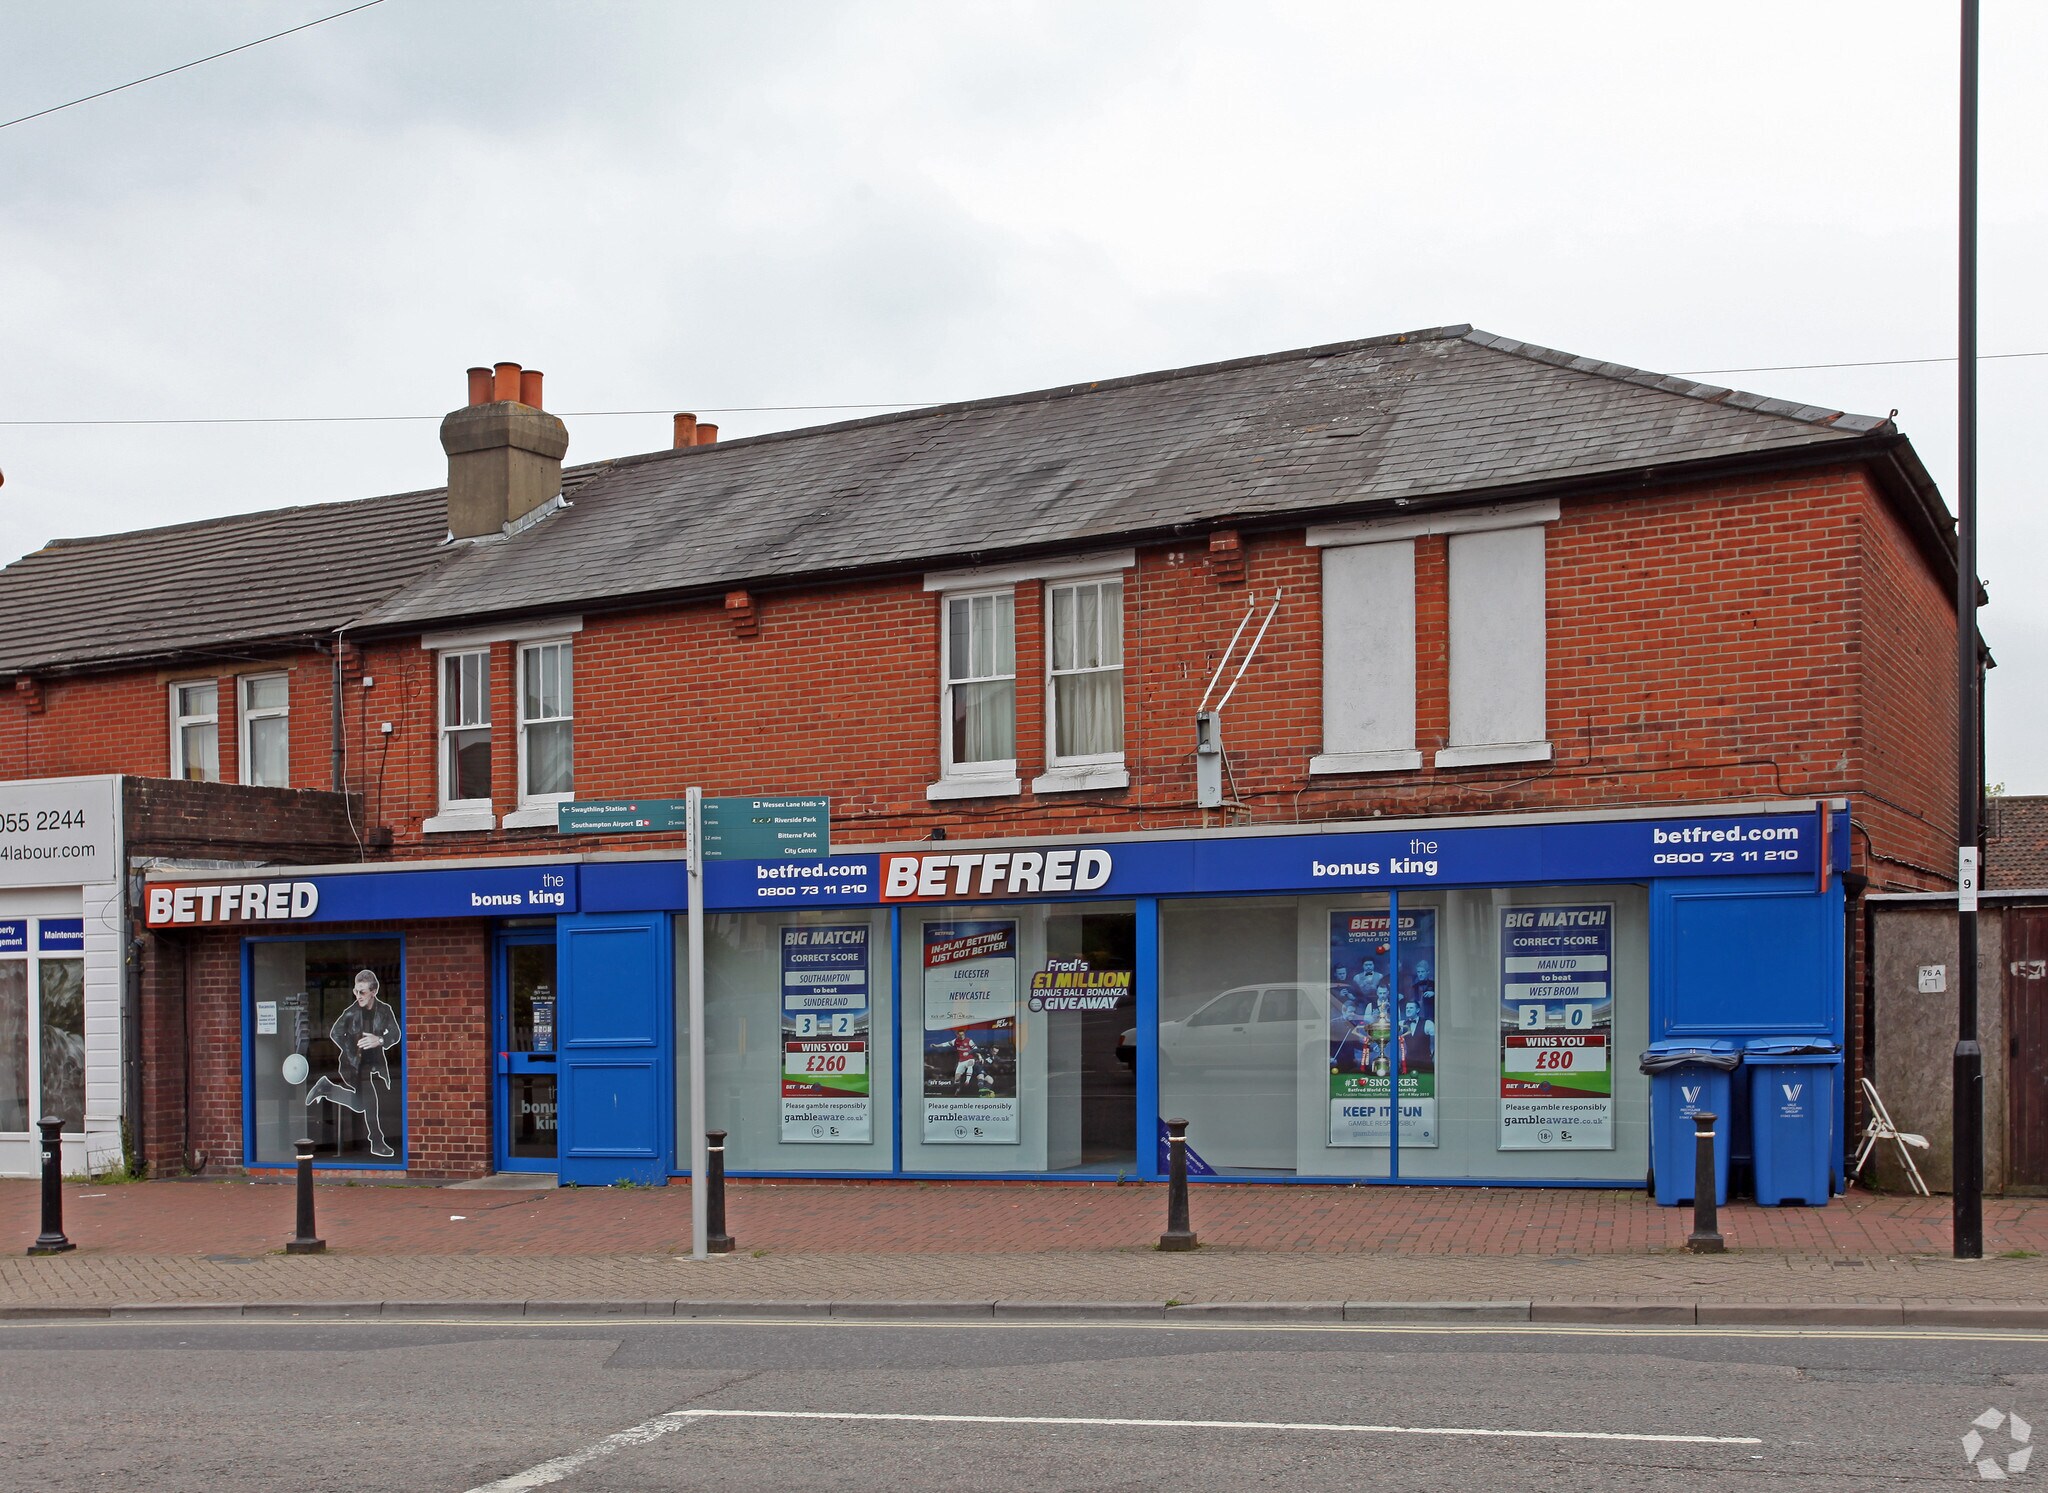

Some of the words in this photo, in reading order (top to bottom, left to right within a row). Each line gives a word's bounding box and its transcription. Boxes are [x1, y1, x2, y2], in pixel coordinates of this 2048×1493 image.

[571, 806, 604, 814] Swaythling
[605, 804, 627, 812] Station
[36, 809, 86, 831] 2244
[571, 821, 611, 829] Southampton
[612, 820, 634, 828] Airport
[802, 831, 817, 839] Park
[1653, 826, 1799, 844] betfred.com
[0, 844, 95, 861] 4labour.com
[784, 847, 798, 855] City
[1410, 838, 1438, 854] the
[1654, 853, 1704, 864] 0800
[1710, 852, 1735, 862] 73
[1740, 851, 1758, 861] 11
[1764, 850, 1799, 861] 210
[757, 863, 867, 879] betfred.com
[885, 849, 1113, 897] BETFRED
[1312, 861, 1380, 877] bonus
[1390, 858, 1438, 876] king
[543, 873, 564, 887] the
[1963, 879, 1971, 889] 9
[758, 887, 796, 897] 0800
[801, 886, 819, 895] 73
[824, 885, 837, 894] 11
[841, 884, 867, 894] 210
[148, 882, 319, 924] BETFRED
[471, 892, 522, 906] bonus
[529, 890, 565, 906] king
[1505, 912, 1534, 928] BIG
[1537, 911, 1607, 927] MATCH!
[44, 931, 84, 939] Maintenanc
[784, 932, 808, 945] BIG
[810, 930, 865, 945] MATCH!
[1513, 937, 1561, 947] CORRECT
[1563, 936, 1598, 945] SCORE
[931, 940, 965, 954] IN-PLAY
[966, 932, 1003, 947] BETTING
[791, 954, 829, 962] CORRECT
[830, 953, 859, 961] SCORE
[931, 952, 952, 964] JUST
[953, 948, 971, 959] GOT
[971, 941, 1008, 955] BETTER!
[1047, 959, 1088, 972] Fred's
[1537, 960, 1558, 969] MAN
[1560, 959, 1577, 969] UTD
[800, 973, 851, 983] SOUTHAMPTON
[954, 969, 990, 979] LEICESTER
[1922, 969, 1932, 977] 76
[1033, 973, 1053, 988] £1
[1055, 972, 1130, 988] MILLION
[949, 991, 991, 1000] NEWCASTLE
[1033, 989, 1062, 997] BONUS
[1086, 988, 1128, 996] BONANZA
[1529, 987, 1552, 996] WEST
[1553, 986, 1579, 996] BROM
[803, 998, 848, 1007] SUNDERLAND
[1044, 997, 1118, 1010] GIVEAWAY
[1527, 1009, 1538, 1026] 3
[1571, 1009, 1583, 1026] 0
[802, 1018, 811, 1033] 3
[838, 1018, 848, 1033] 2
[801, 1044, 827, 1052] WINS
[828, 1043, 849, 1051] YOU
[1526, 1037, 1558, 1047] WINS
[1560, 1037, 1586, 1047] YOU
[805, 1055, 846, 1072] £260
[1535, 1050, 1574, 1070] £80
[1369, 1078, 1418, 1087] SNOKER
[548, 1085, 557, 1099] th
[521, 1100, 557, 1114] bonu
[1343, 1107, 1376, 1117] KEEP
[1380, 1107, 1390, 1117] IT
[1531, 1104, 1560, 1112] gamble
[1561, 1104, 1607, 1112] responsibly
[536, 1115, 557, 1130] kin
